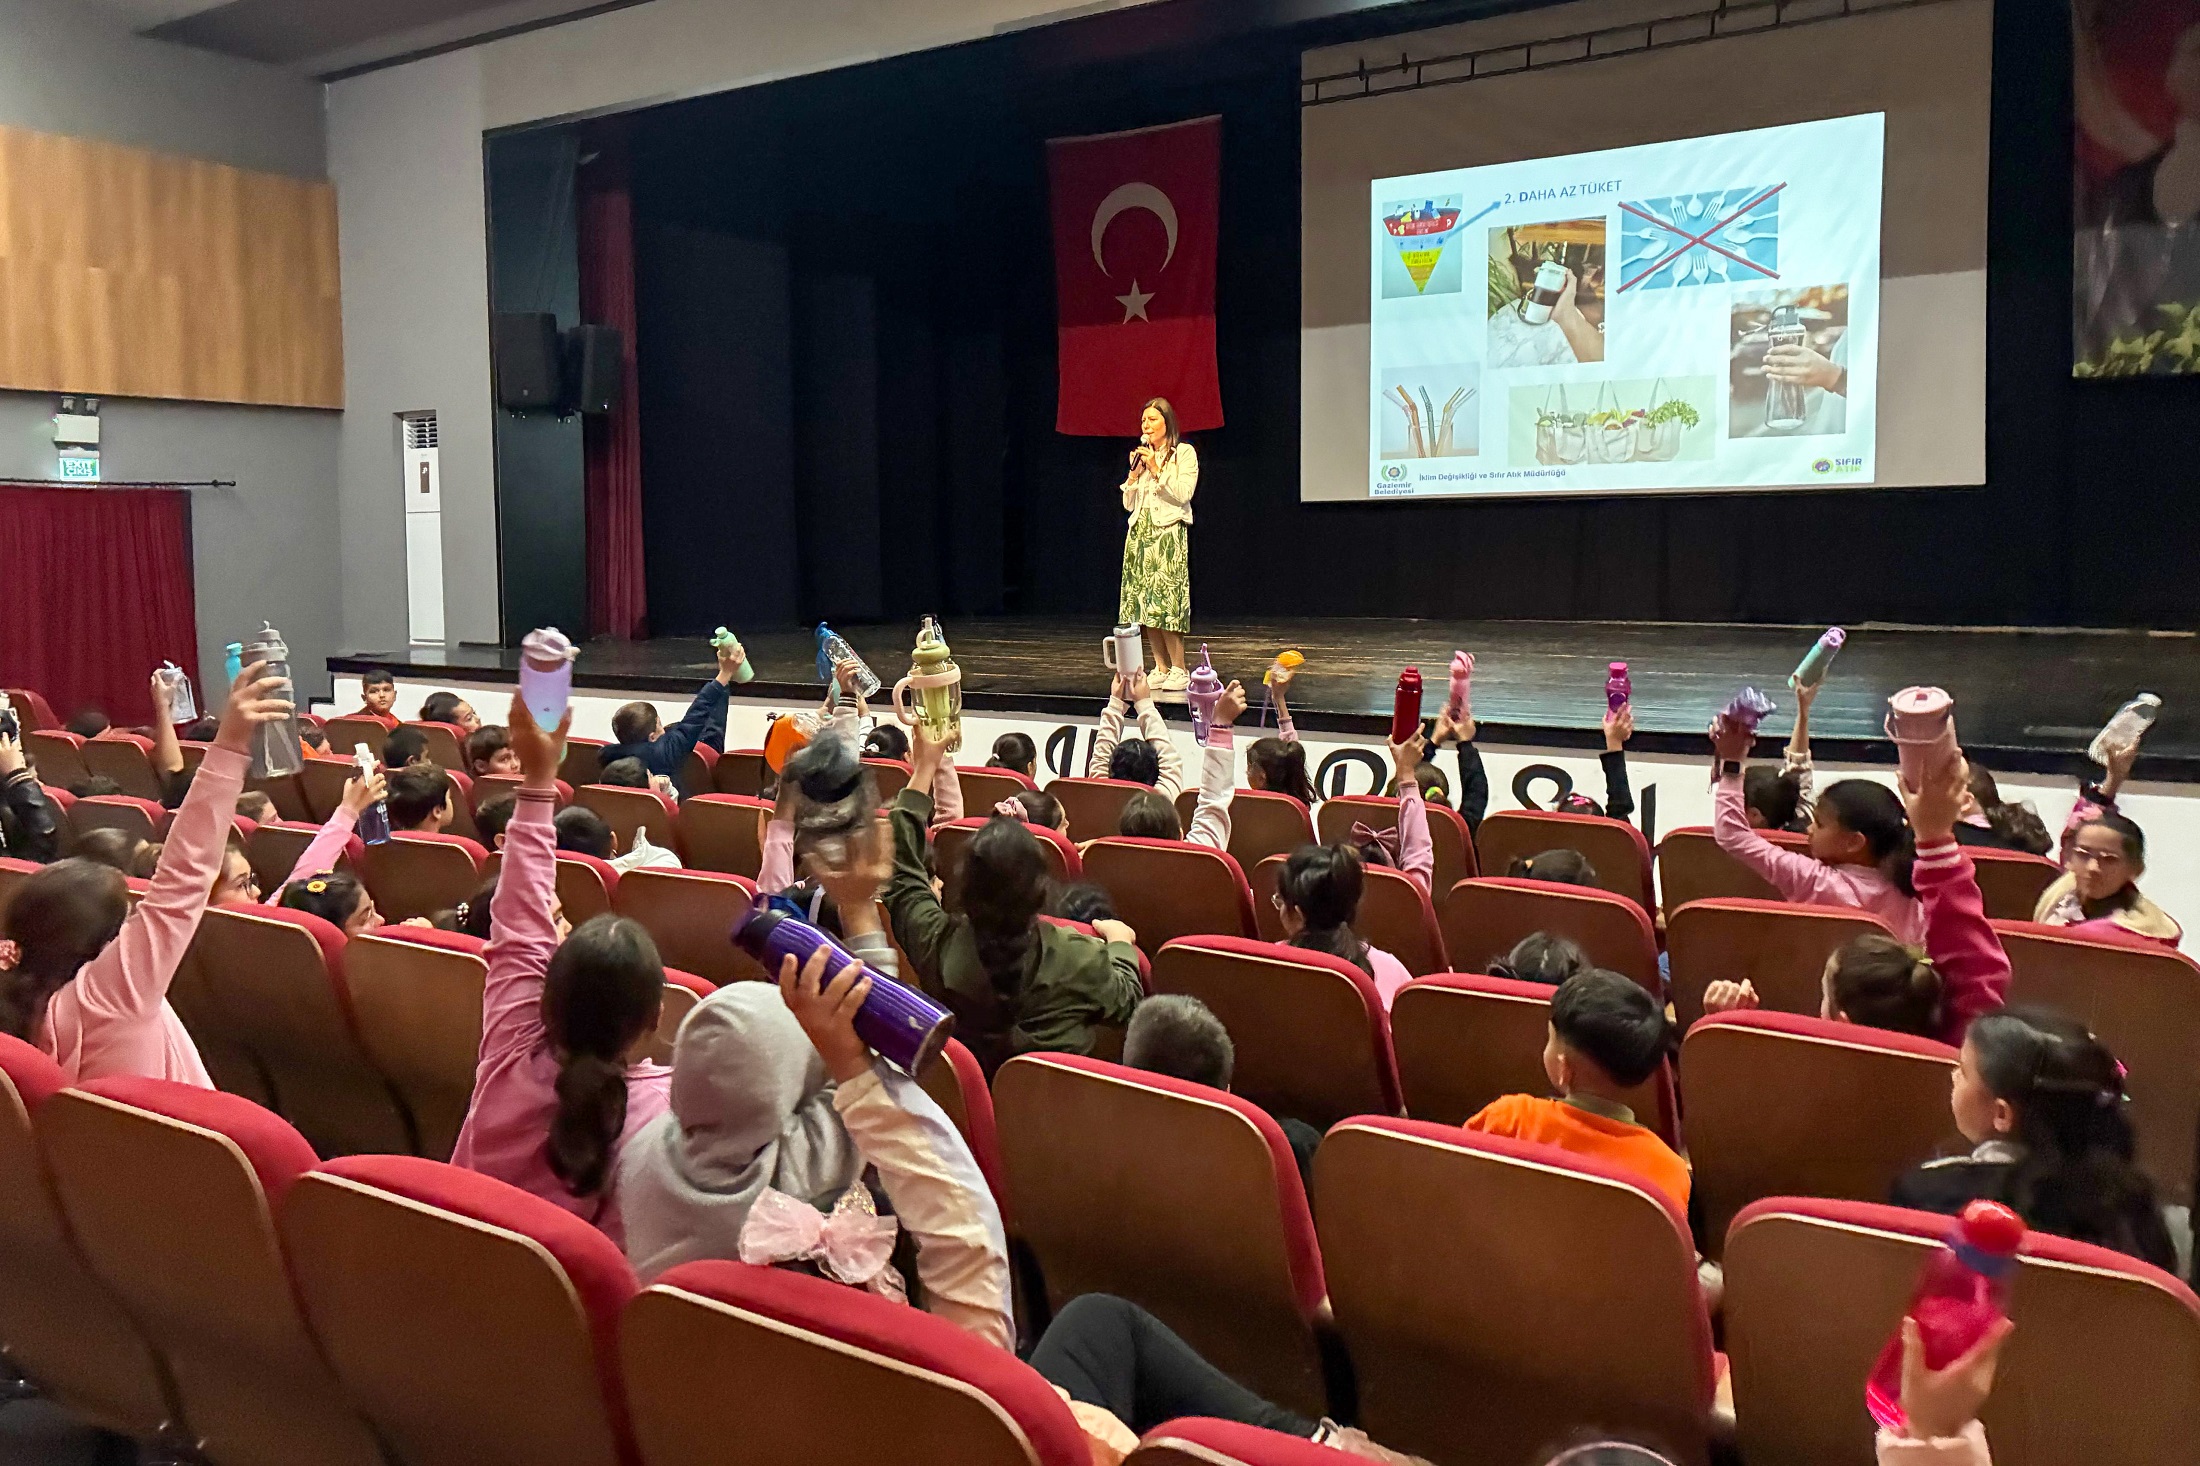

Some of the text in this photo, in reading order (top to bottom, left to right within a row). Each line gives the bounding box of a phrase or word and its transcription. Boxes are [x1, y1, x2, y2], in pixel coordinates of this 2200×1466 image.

[1504, 180, 1622, 204] 2. DAHA AZ TÜKET
[66, 460, 92, 468] EXIT
[1835, 458, 1862, 466] SIFIR
